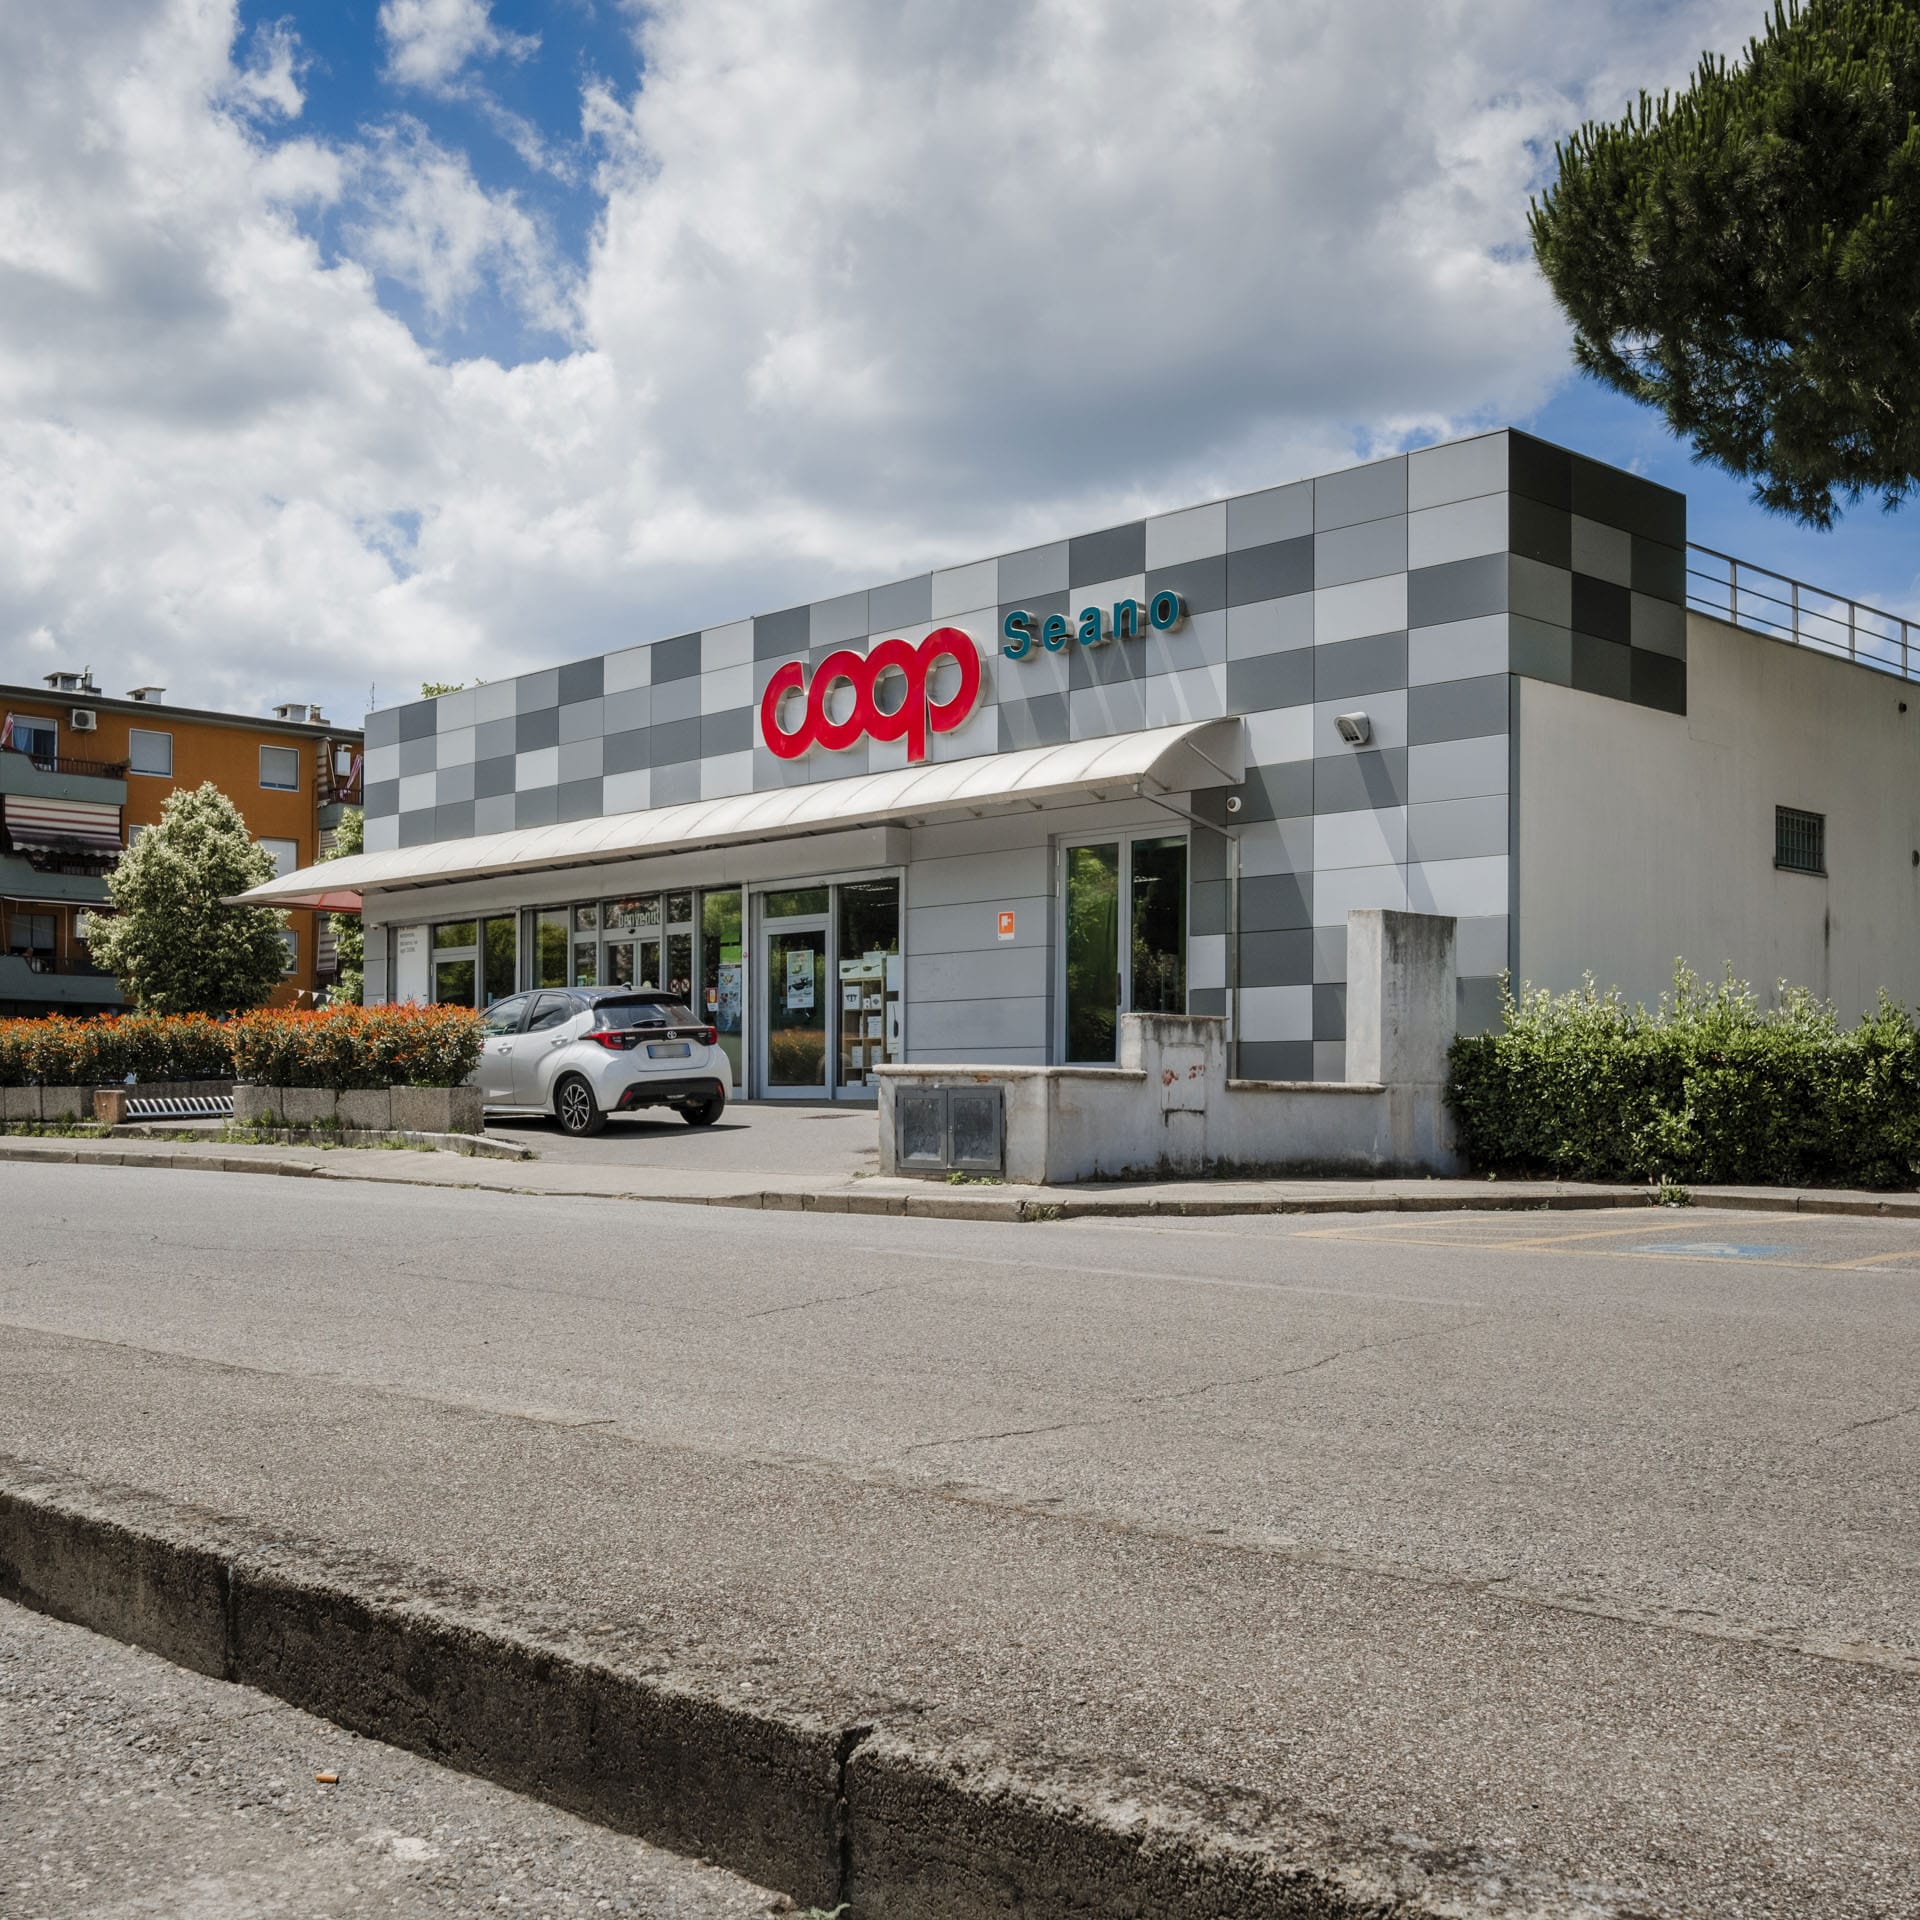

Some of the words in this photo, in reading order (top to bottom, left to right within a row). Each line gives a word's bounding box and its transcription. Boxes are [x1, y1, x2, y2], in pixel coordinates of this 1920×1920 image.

[1003, 589, 1184, 661] Seano
[761, 627, 982, 762] coop
[618, 908, 661, 928] benvenut
